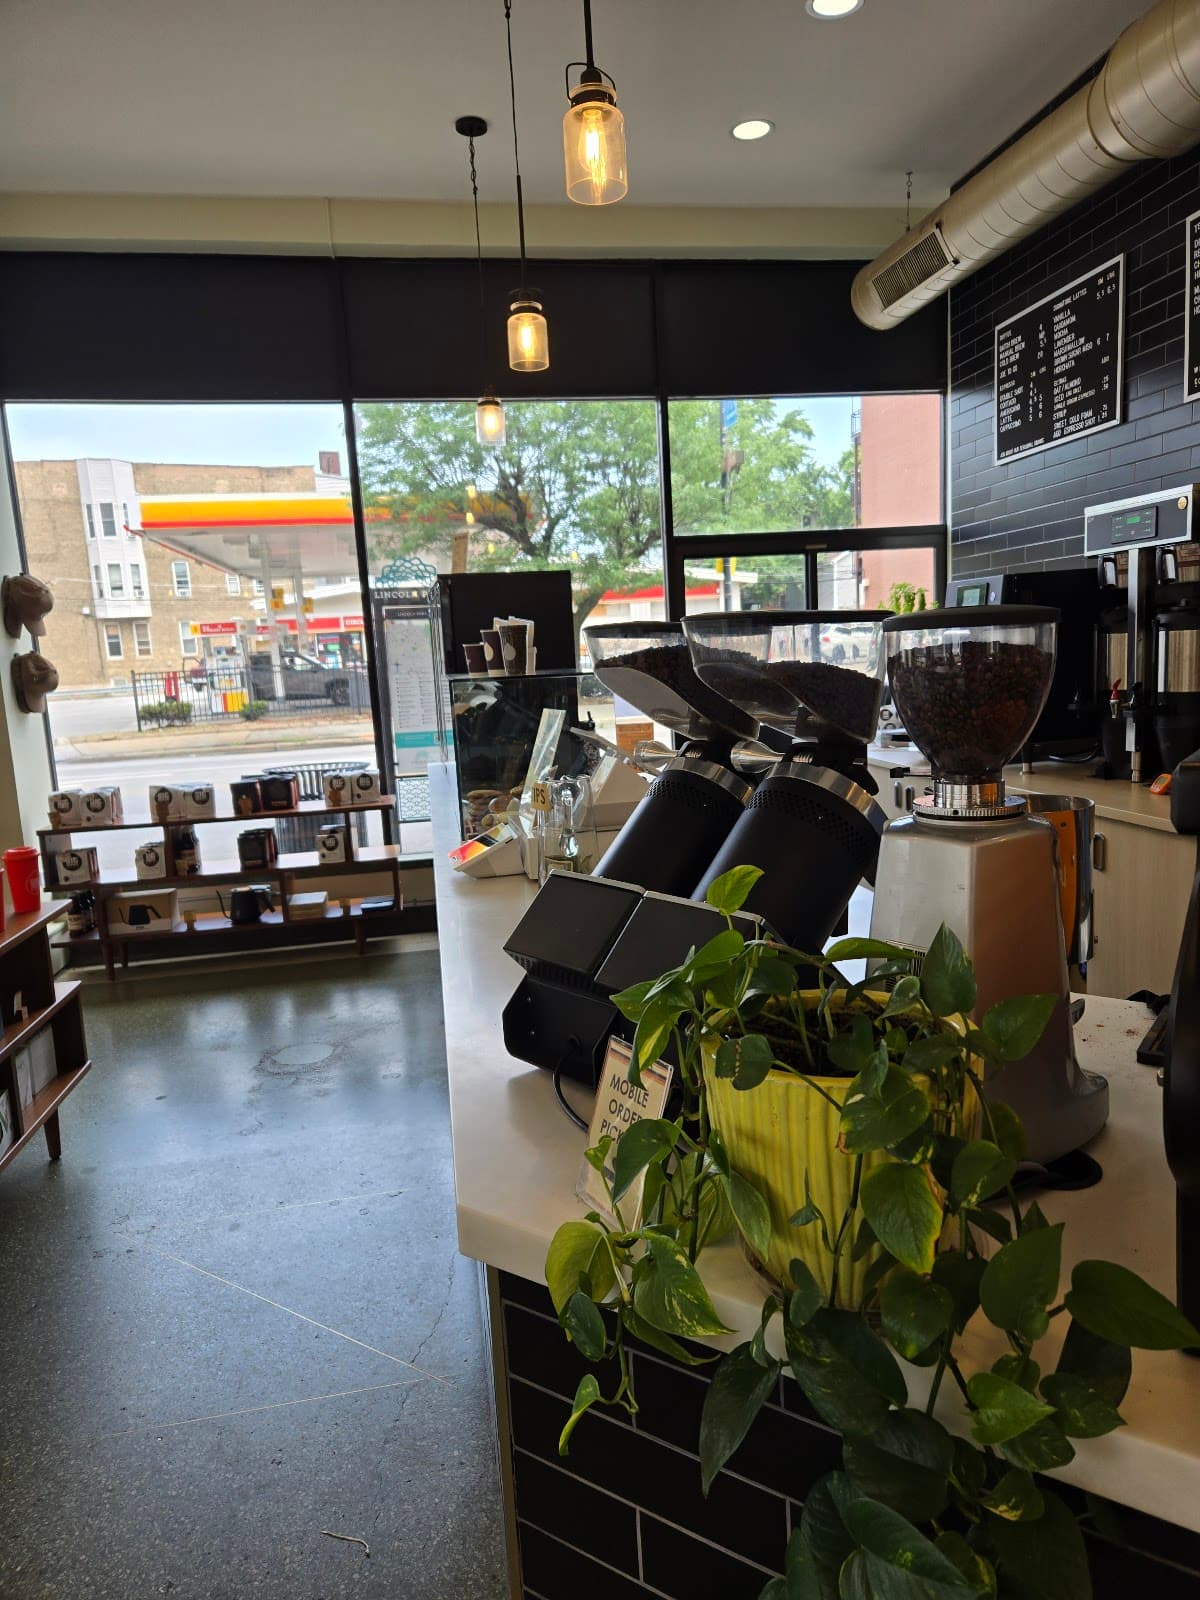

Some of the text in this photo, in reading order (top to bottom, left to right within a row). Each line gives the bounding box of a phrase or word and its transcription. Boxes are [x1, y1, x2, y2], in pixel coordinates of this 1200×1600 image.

[1053, 308, 1071, 323] VANILLA
[1054, 313, 1076, 332] CARDAMOM
[1054, 328, 1069, 340] MOCHA
[1054, 333, 1075, 350] LAVENDER
[1054, 336, 1085, 357] MARSHMALLOW
[1054, 359, 1075, 375] HORCHATA
[1000, 415, 1012, 425] LATTE
[1063, 420, 1085, 435] ESPRESSO
[1085, 416, 1096, 428] SHOT
[532, 786, 546, 805] IPS
[609, 1073, 649, 1109] MOBILE
